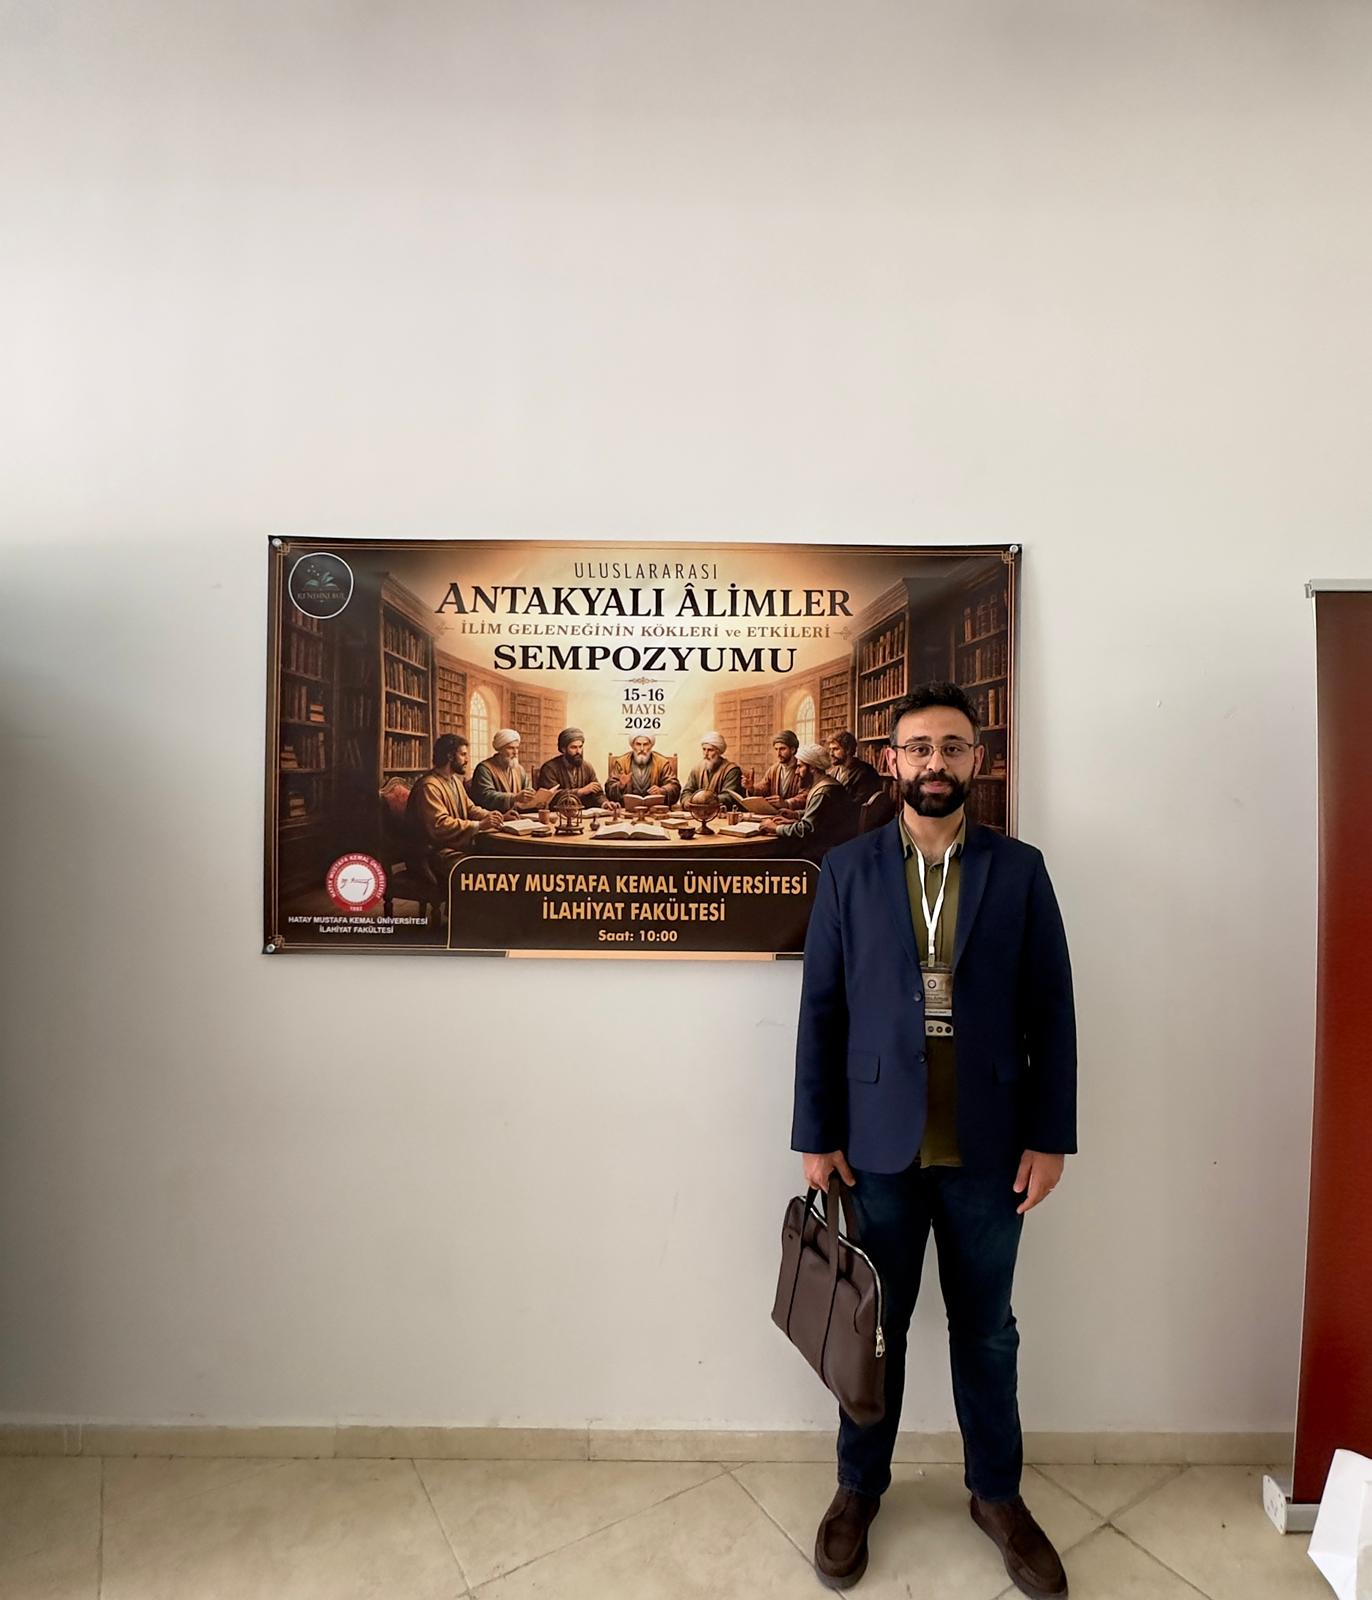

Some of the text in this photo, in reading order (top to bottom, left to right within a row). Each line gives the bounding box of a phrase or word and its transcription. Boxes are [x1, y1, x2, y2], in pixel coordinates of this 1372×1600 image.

[574, 562, 718, 579] ULUSLARARASI
[434, 582, 854, 617] ANTAKYALI ÂLİMLER
[461, 619, 831, 638] İLİM GELENEĞİNİN KÖKLERİ ve ETKİLERİ
[494, 644, 798, 673] SEMPOZYUMU
[623, 688, 665, 702] 15-16
[621, 703, 666, 715] MAYIS
[624, 716, 661, 729] 2026
[460, 870, 808, 895] HATAY MUSTAFA KEMAL ÜNİVERSİTESİ
[542, 896, 725, 921] İLAHİYAT FAKÜLTESİ
[313, 916, 348, 924] MUSTAFA
[377, 916, 428, 925] ÜNİVERSİTESİ
[319, 925, 394, 934] İLAHİYAT FAKÜLTESİ
[598, 929, 678, 942] Saat: 10:00
